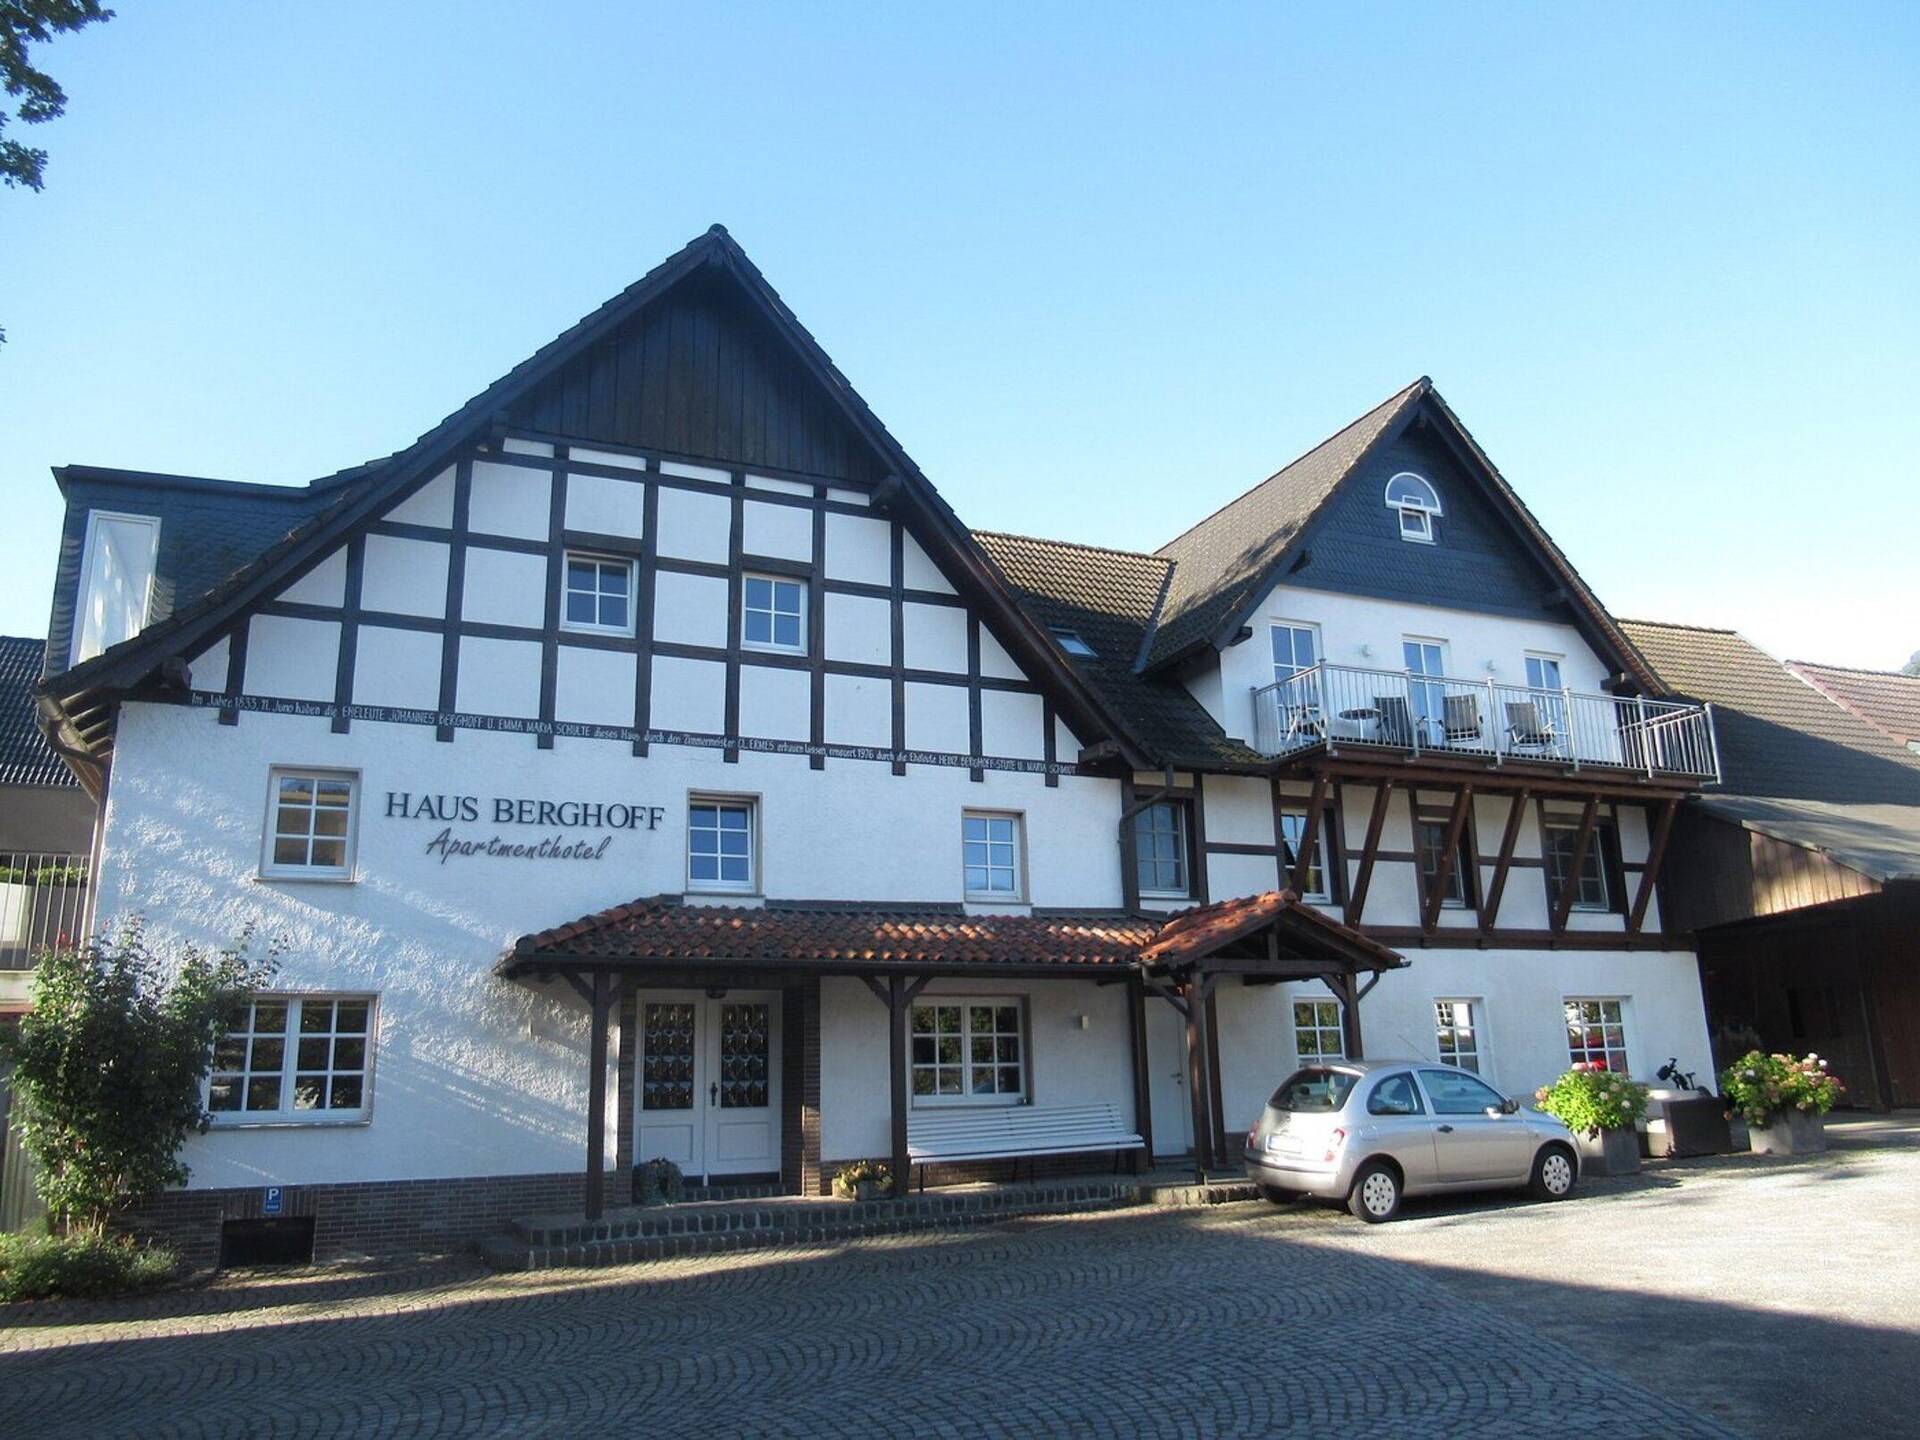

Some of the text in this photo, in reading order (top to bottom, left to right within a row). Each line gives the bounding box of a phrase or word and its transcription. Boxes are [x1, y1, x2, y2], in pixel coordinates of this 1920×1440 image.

[191, 693, 203, 705] Im
[206, 694, 233, 709] Jahre
[295, 702, 320, 716] haben
[324, 705, 337, 717] die
[342, 706, 385, 720] EHELEUTE
[390, 710, 435, 725] JOHANNES
[439, 714, 482, 729] BERGHOFF
[499, 719, 523, 731] EMMA
[526, 721, 552, 734] MARIA
[556, 724, 590, 737] SCHULTE
[594, 728, 617, 740] dieses
[621, 729, 640, 741] Haus
[644, 730, 664, 743] durch
[668, 733, 680, 744] den
[684, 733, 734, 749] Zimmermeister
[876, 750, 895, 762] durch
[897, 751, 907, 762] die
[938, 755, 958, 766] HEINZ
[1026, 762, 1047, 773] MARIA
[385, 791, 666, 830] HAUS BERGHOFF
[426, 827, 612, 864] Apartmenthotel
[268, 1188, 279, 1200] P
